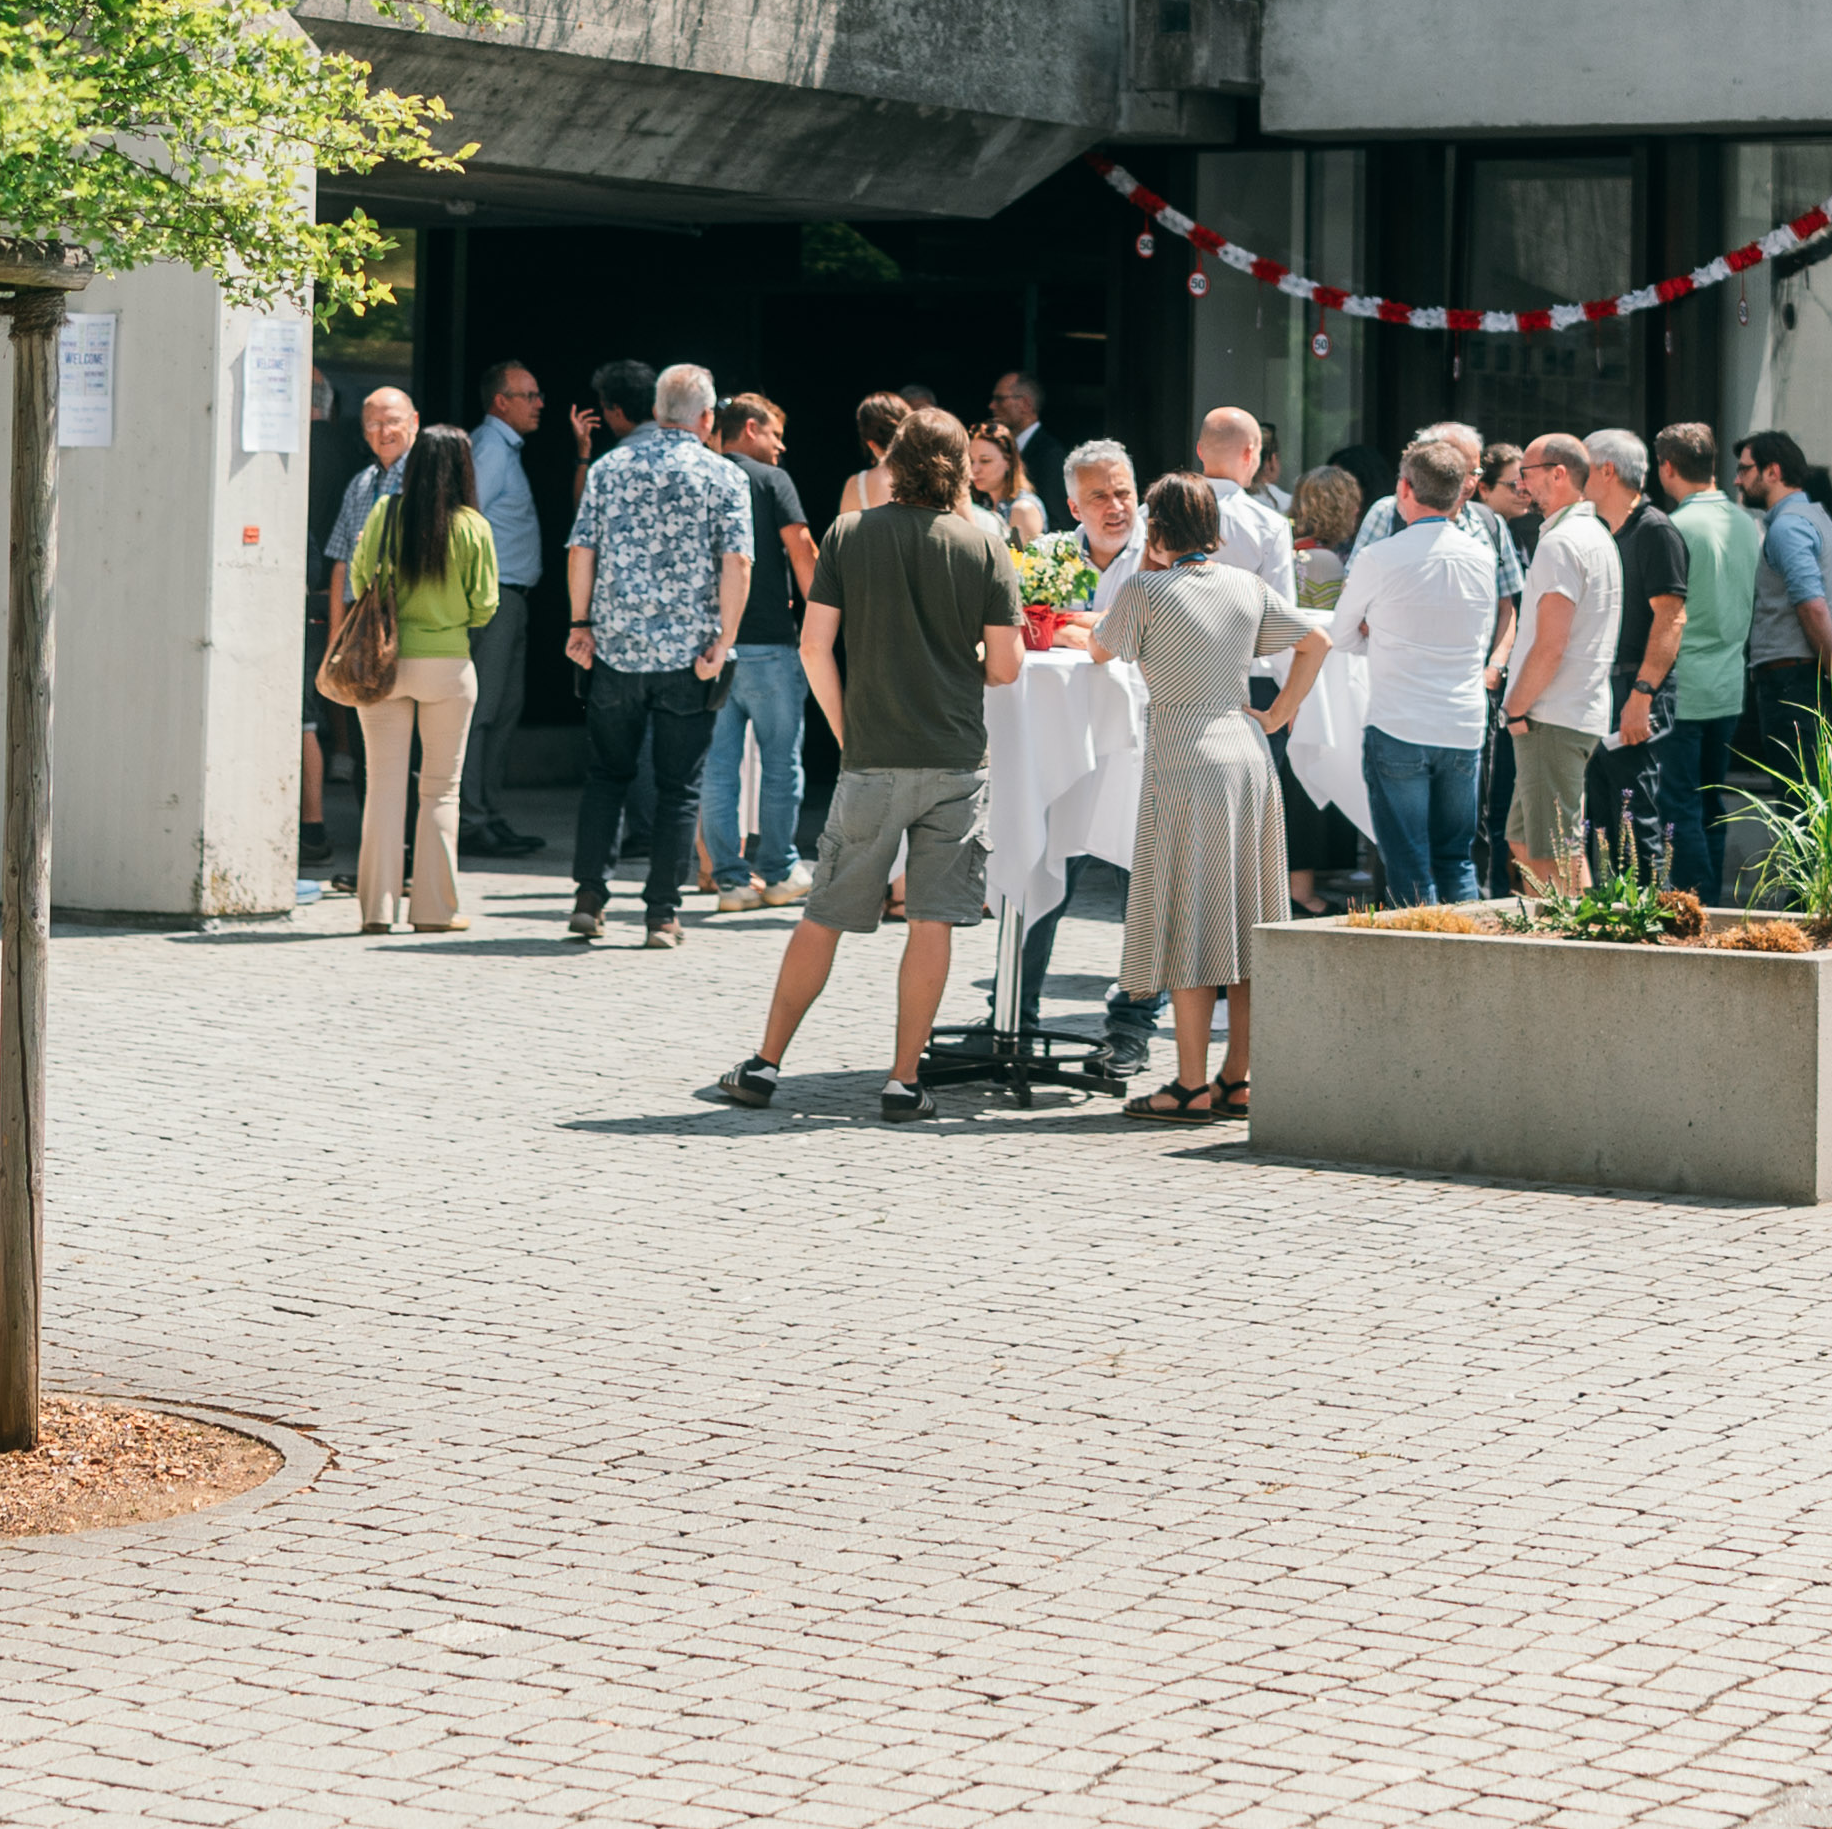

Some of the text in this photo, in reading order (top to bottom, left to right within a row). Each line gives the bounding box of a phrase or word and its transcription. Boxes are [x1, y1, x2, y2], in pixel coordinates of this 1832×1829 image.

[1139, 238, 1153, 251] 50
[1190, 277, 1206, 291] 50
[1314, 338, 1328, 351] 50
[64, 352, 103, 365] WELCOME
